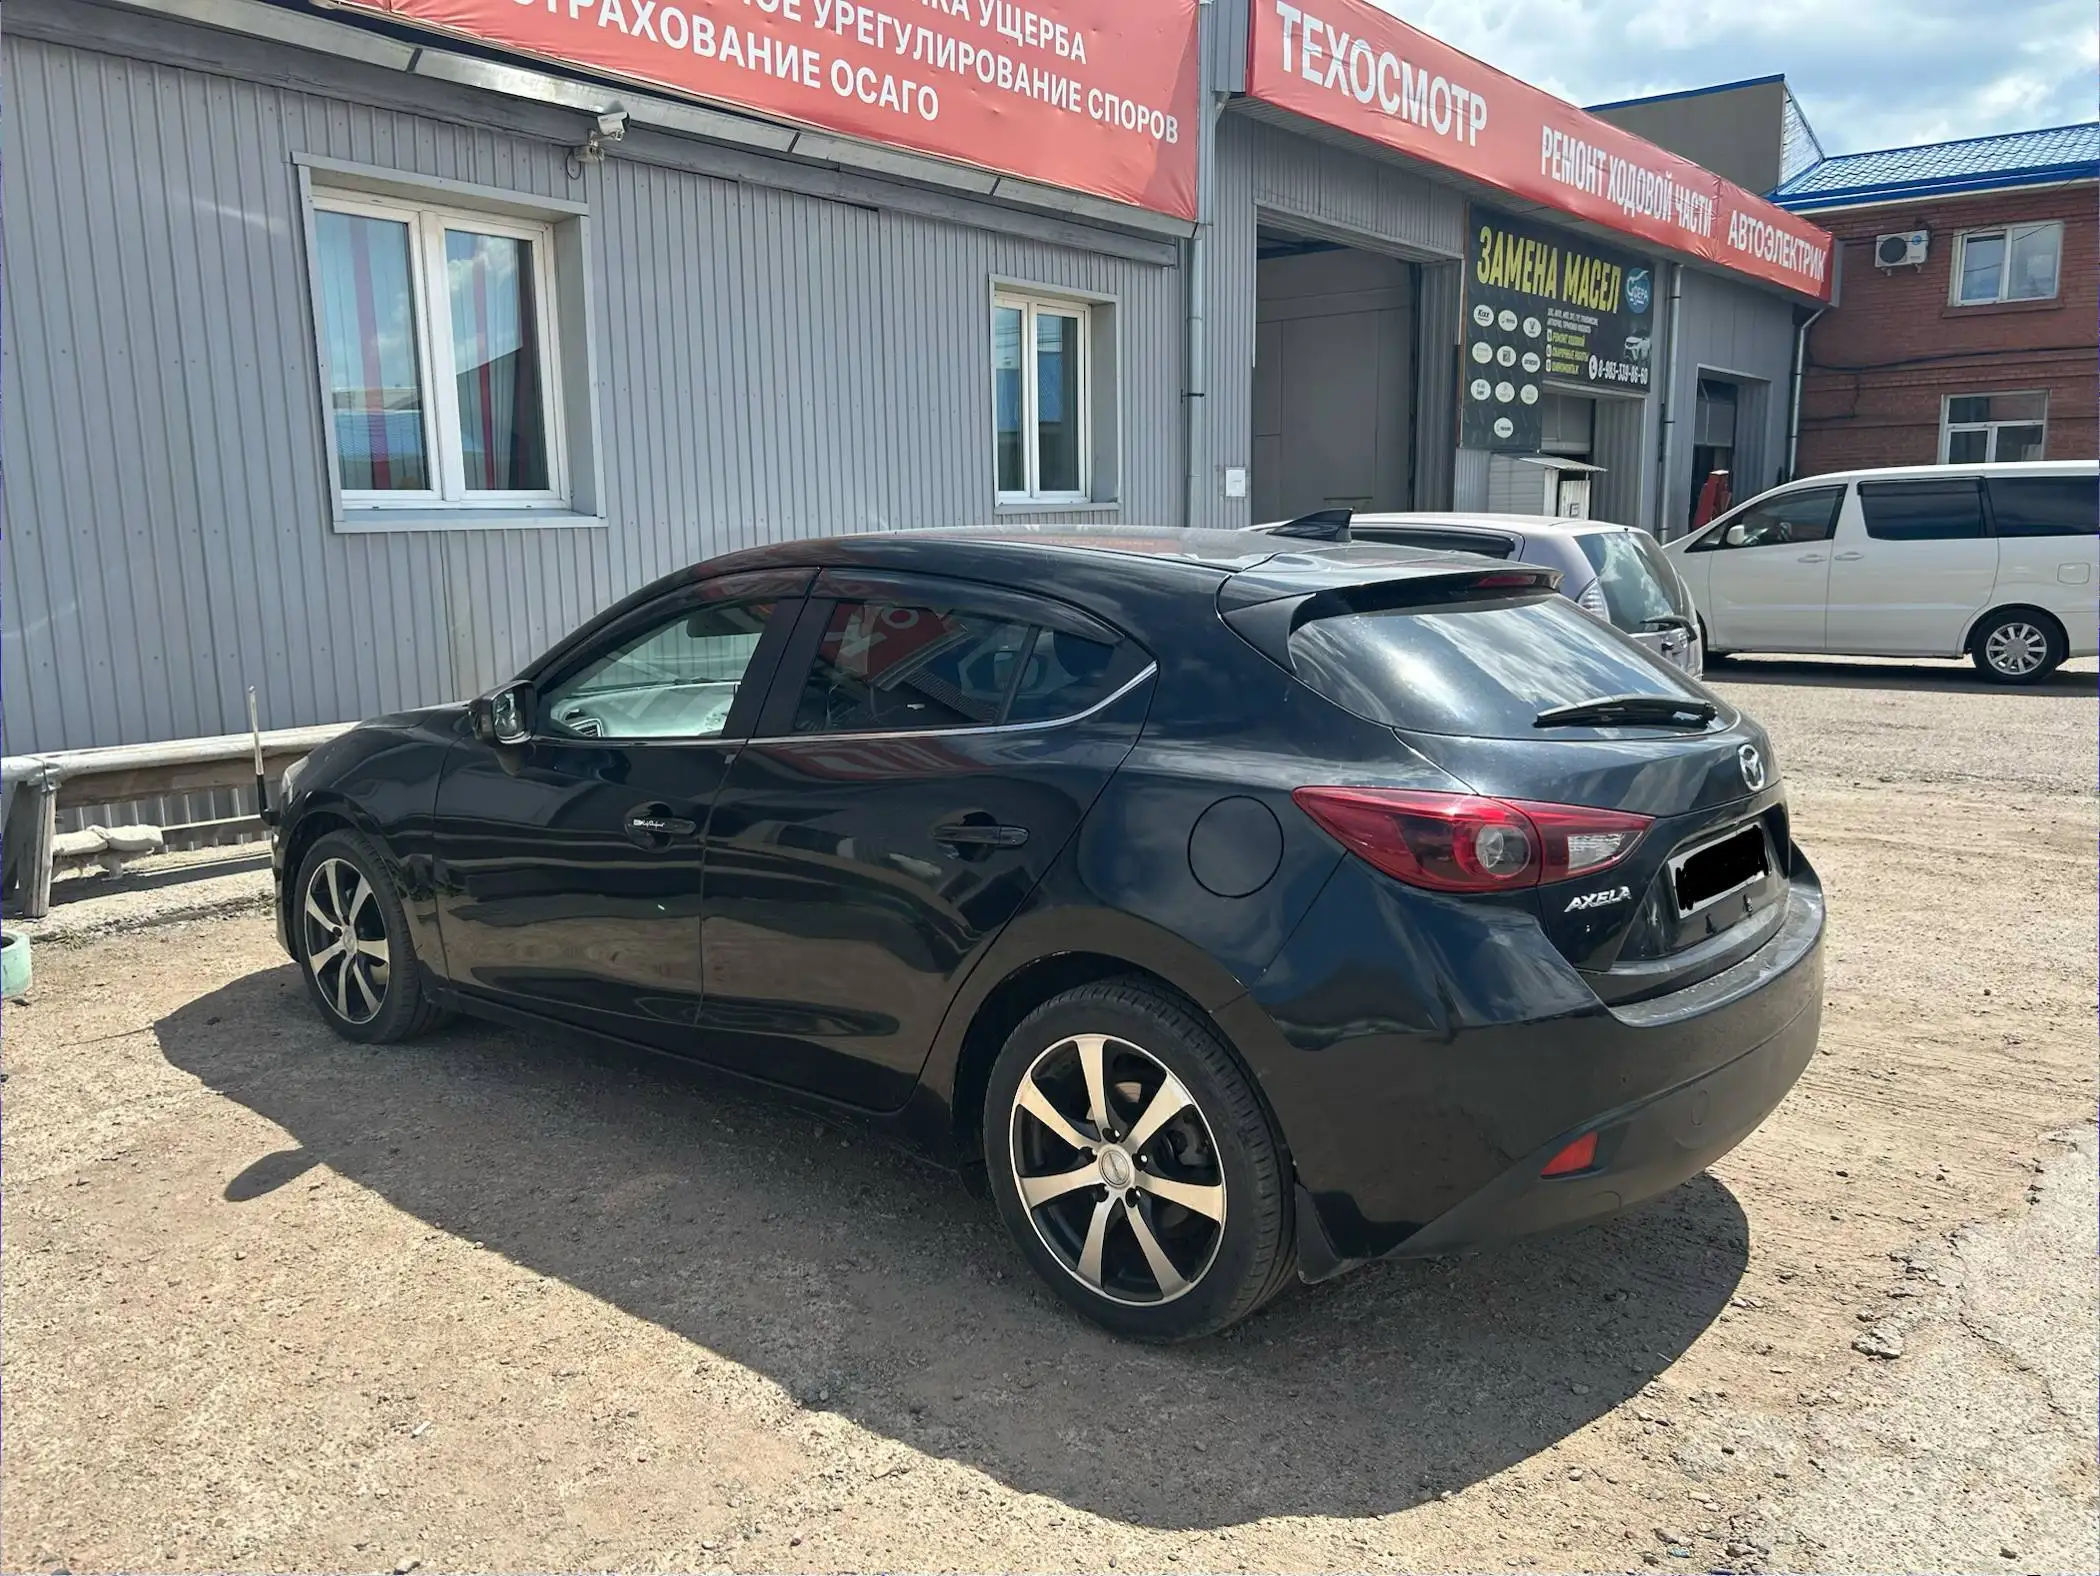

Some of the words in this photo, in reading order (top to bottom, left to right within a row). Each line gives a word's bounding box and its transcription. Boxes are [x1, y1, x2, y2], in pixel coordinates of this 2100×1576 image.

[513, 0, 821, 89] АХОВАНИЕ
[830, 59, 939, 121] ОСАГО
[813, 0, 1082, 113] УРЕГУЛИРОВАНИЕ
[1088, 88, 1178, 144] СПОРОВ
[979, 0, 1087, 64] УЩЕРБА
[1276, 1, 1488, 147] ТЕХОСМОТР
[1542, 125, 1607, 197] РЕМОНТ
[1607, 155, 1673, 224] ХОДОВОЙ
[1675, 184, 1713, 238] ЧАСТИ
[1477, 226, 1558, 299] ЗАМЕНА
[1563, 251, 1622, 314] МАСЕЛ
[1727, 209, 1826, 283] АВТОЭЛЕКТРИК
[1563, 885, 1632, 912] AXELA
